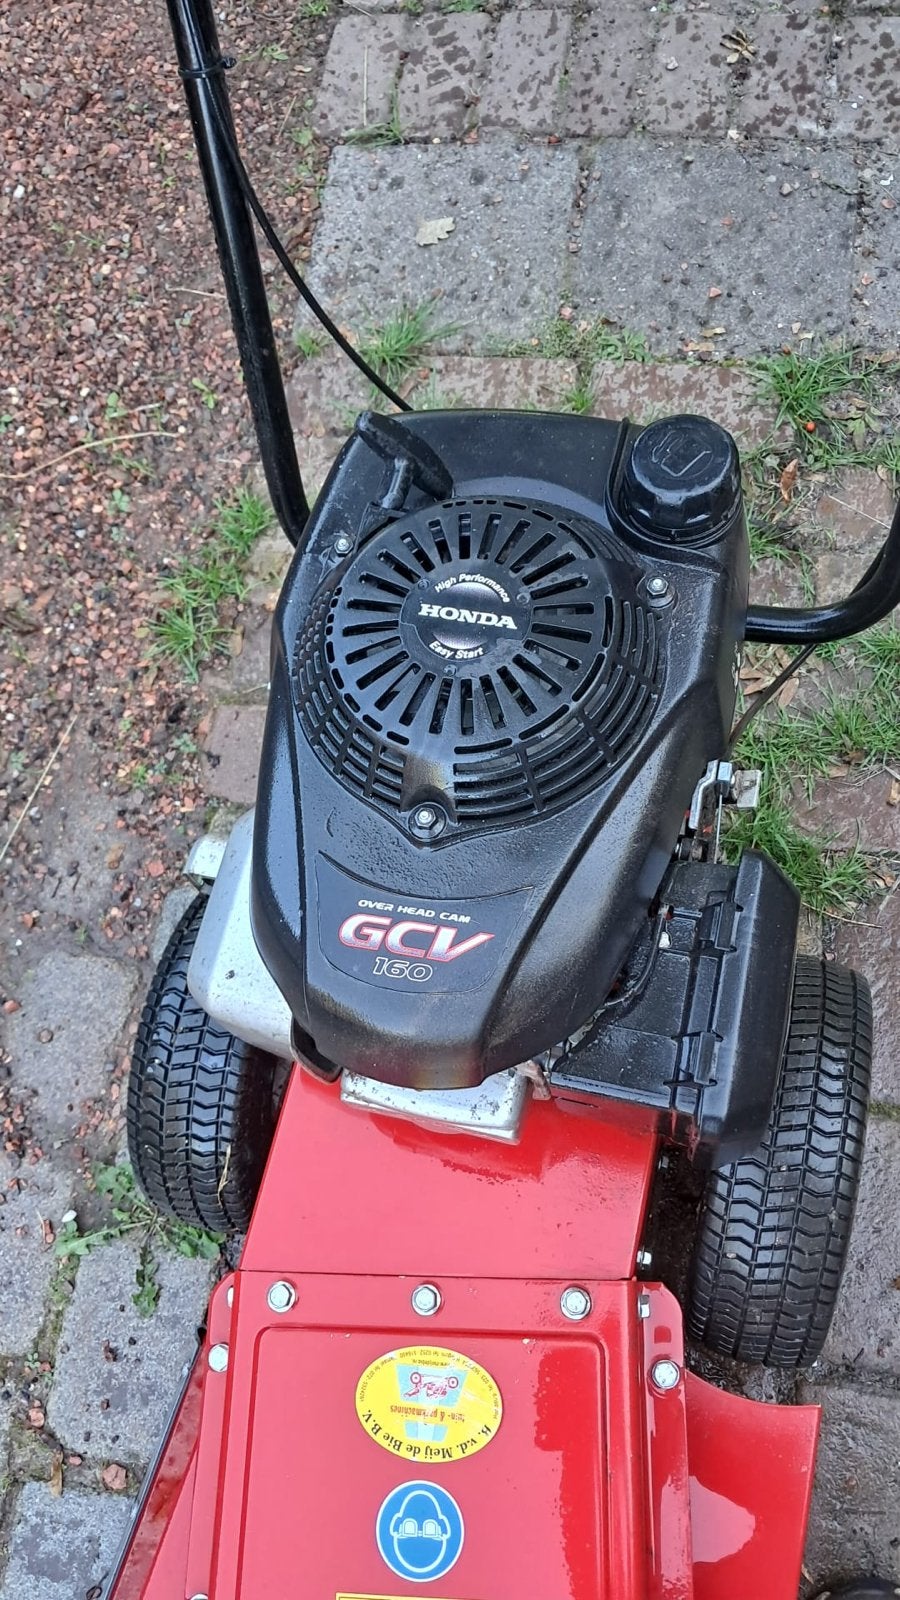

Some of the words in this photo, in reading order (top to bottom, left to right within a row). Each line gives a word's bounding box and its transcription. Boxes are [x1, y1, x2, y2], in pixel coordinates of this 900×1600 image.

[434, 576, 457, 593] High
[459, 573, 511, 603] Performance
[418, 603, 518, 630] HONDA
[429, 640, 454, 659] Easy
[454, 647, 484, 659] Start
[357, 899, 394, 912] OVER
[397, 905, 436, 918] HEAD
[439, 911, 471, 924] CAM
[337, 912, 496, 963] GCV
[372, 956, 434, 983] 160
[383, 1432, 404, 1452] Bie
[406, 1446, 421, 1458] de
[424, 1445, 453, 1460] Meij
